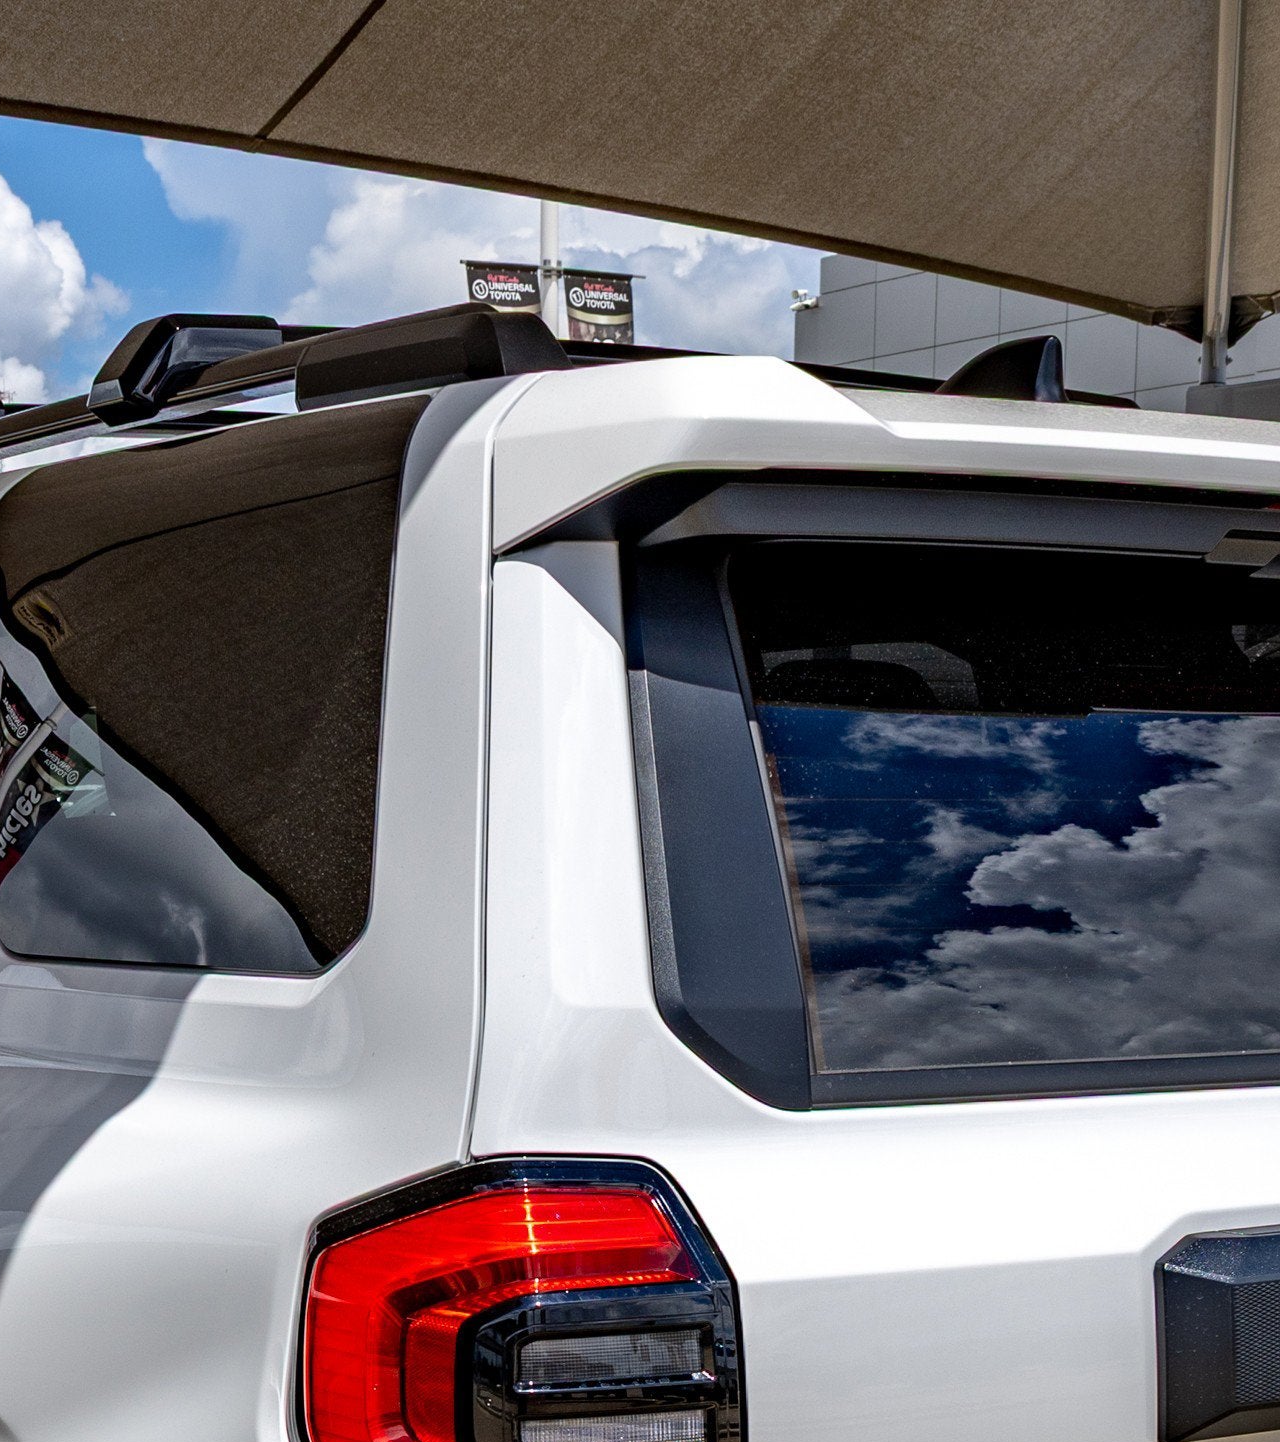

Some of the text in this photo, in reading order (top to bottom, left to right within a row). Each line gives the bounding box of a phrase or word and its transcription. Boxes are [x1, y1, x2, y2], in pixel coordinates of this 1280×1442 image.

[488, 282, 535, 293] UNIVERSAL
[489, 290, 521, 301] TOYOTA
[585, 290, 629, 302] UNIVERSAL
[586, 299, 615, 310] TOYOTA
